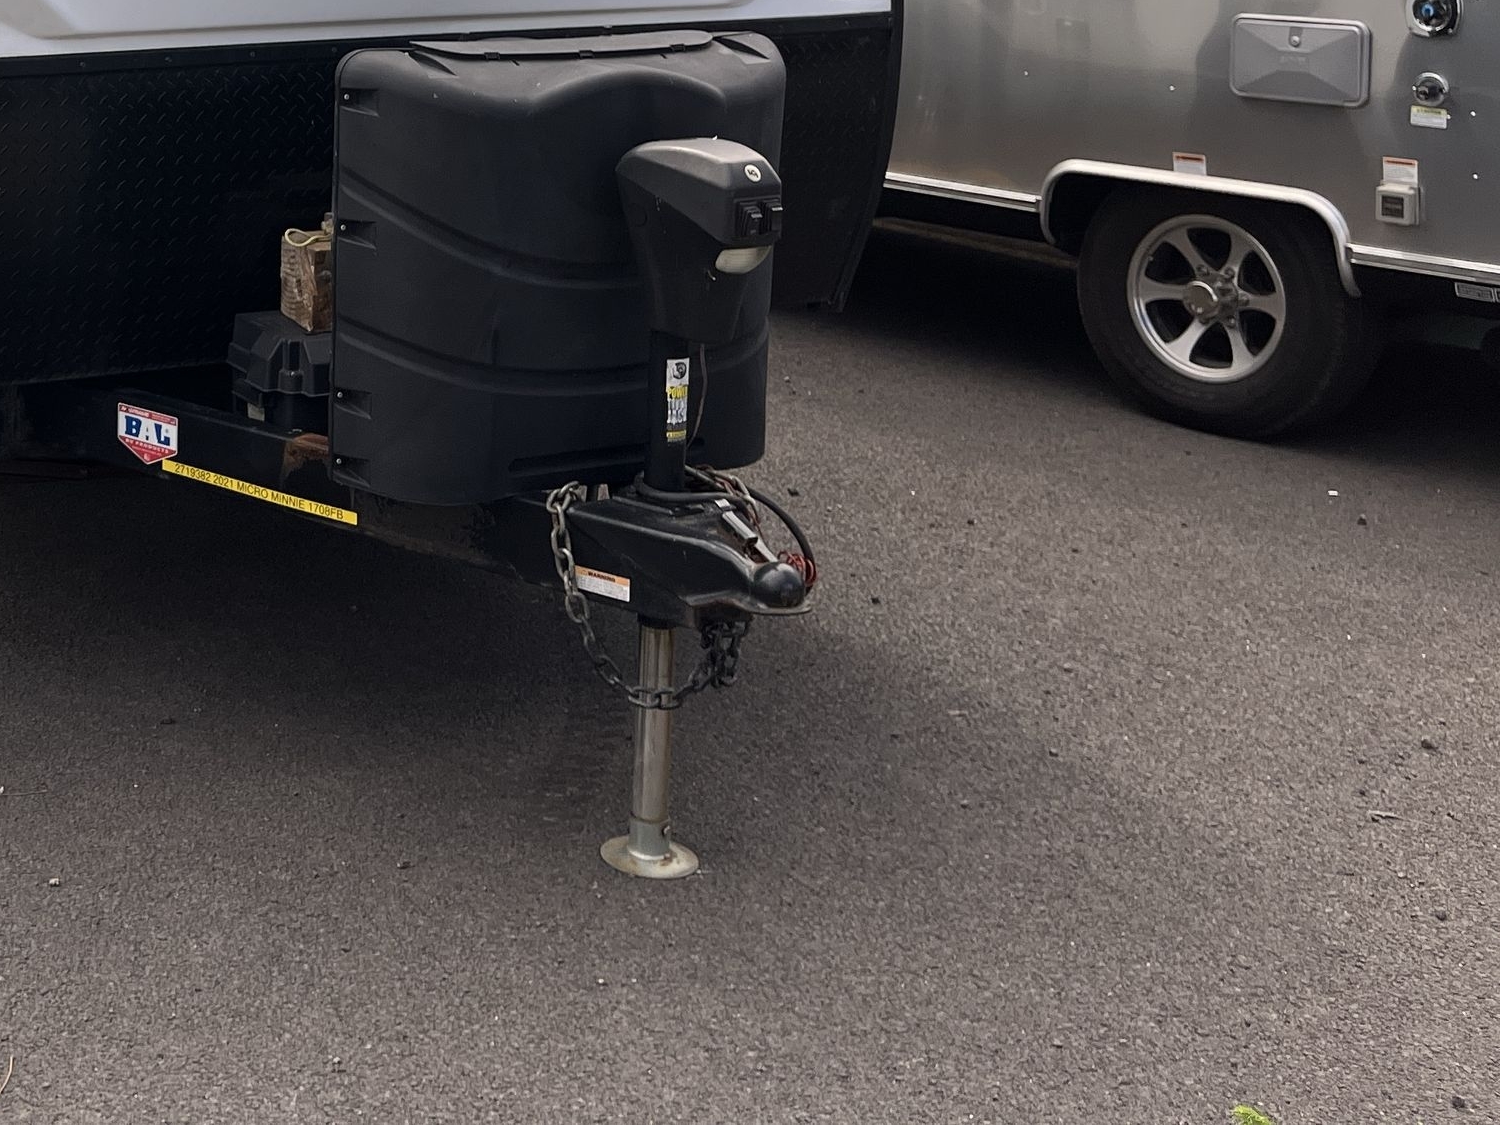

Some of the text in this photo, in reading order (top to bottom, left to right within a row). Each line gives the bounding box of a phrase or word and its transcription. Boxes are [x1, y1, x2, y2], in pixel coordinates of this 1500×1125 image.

[124, 415, 171, 446] BAL
[175, 463, 344, 520] 2719382 2021 MICRO MINNIE 1708FB
